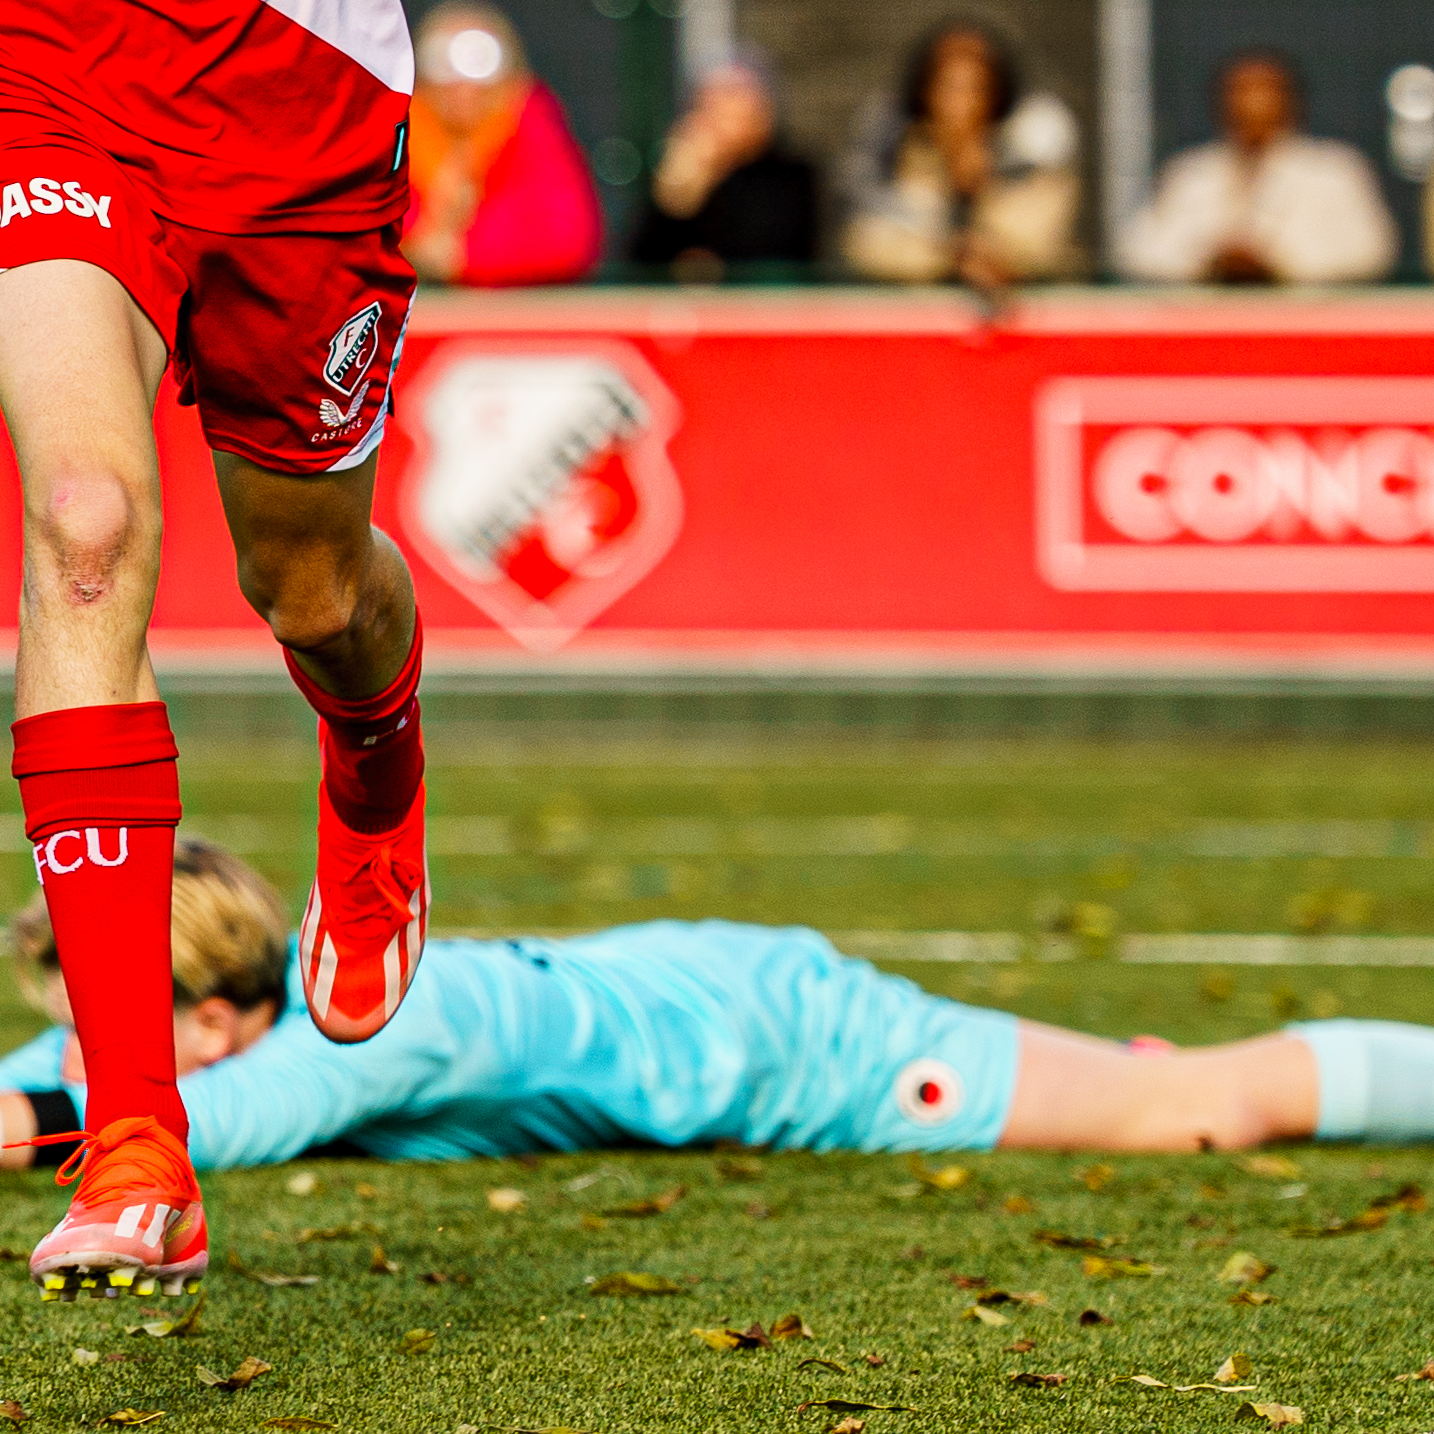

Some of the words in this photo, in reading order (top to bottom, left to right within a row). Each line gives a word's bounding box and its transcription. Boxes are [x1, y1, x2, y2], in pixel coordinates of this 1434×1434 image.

[332, 313, 376, 383] UTRECHT
[342, 326, 355, 348] F
[355, 348, 367, 369] C
[311, 417, 363, 442] CASTORE
[33, 827, 129, 885] FCU
